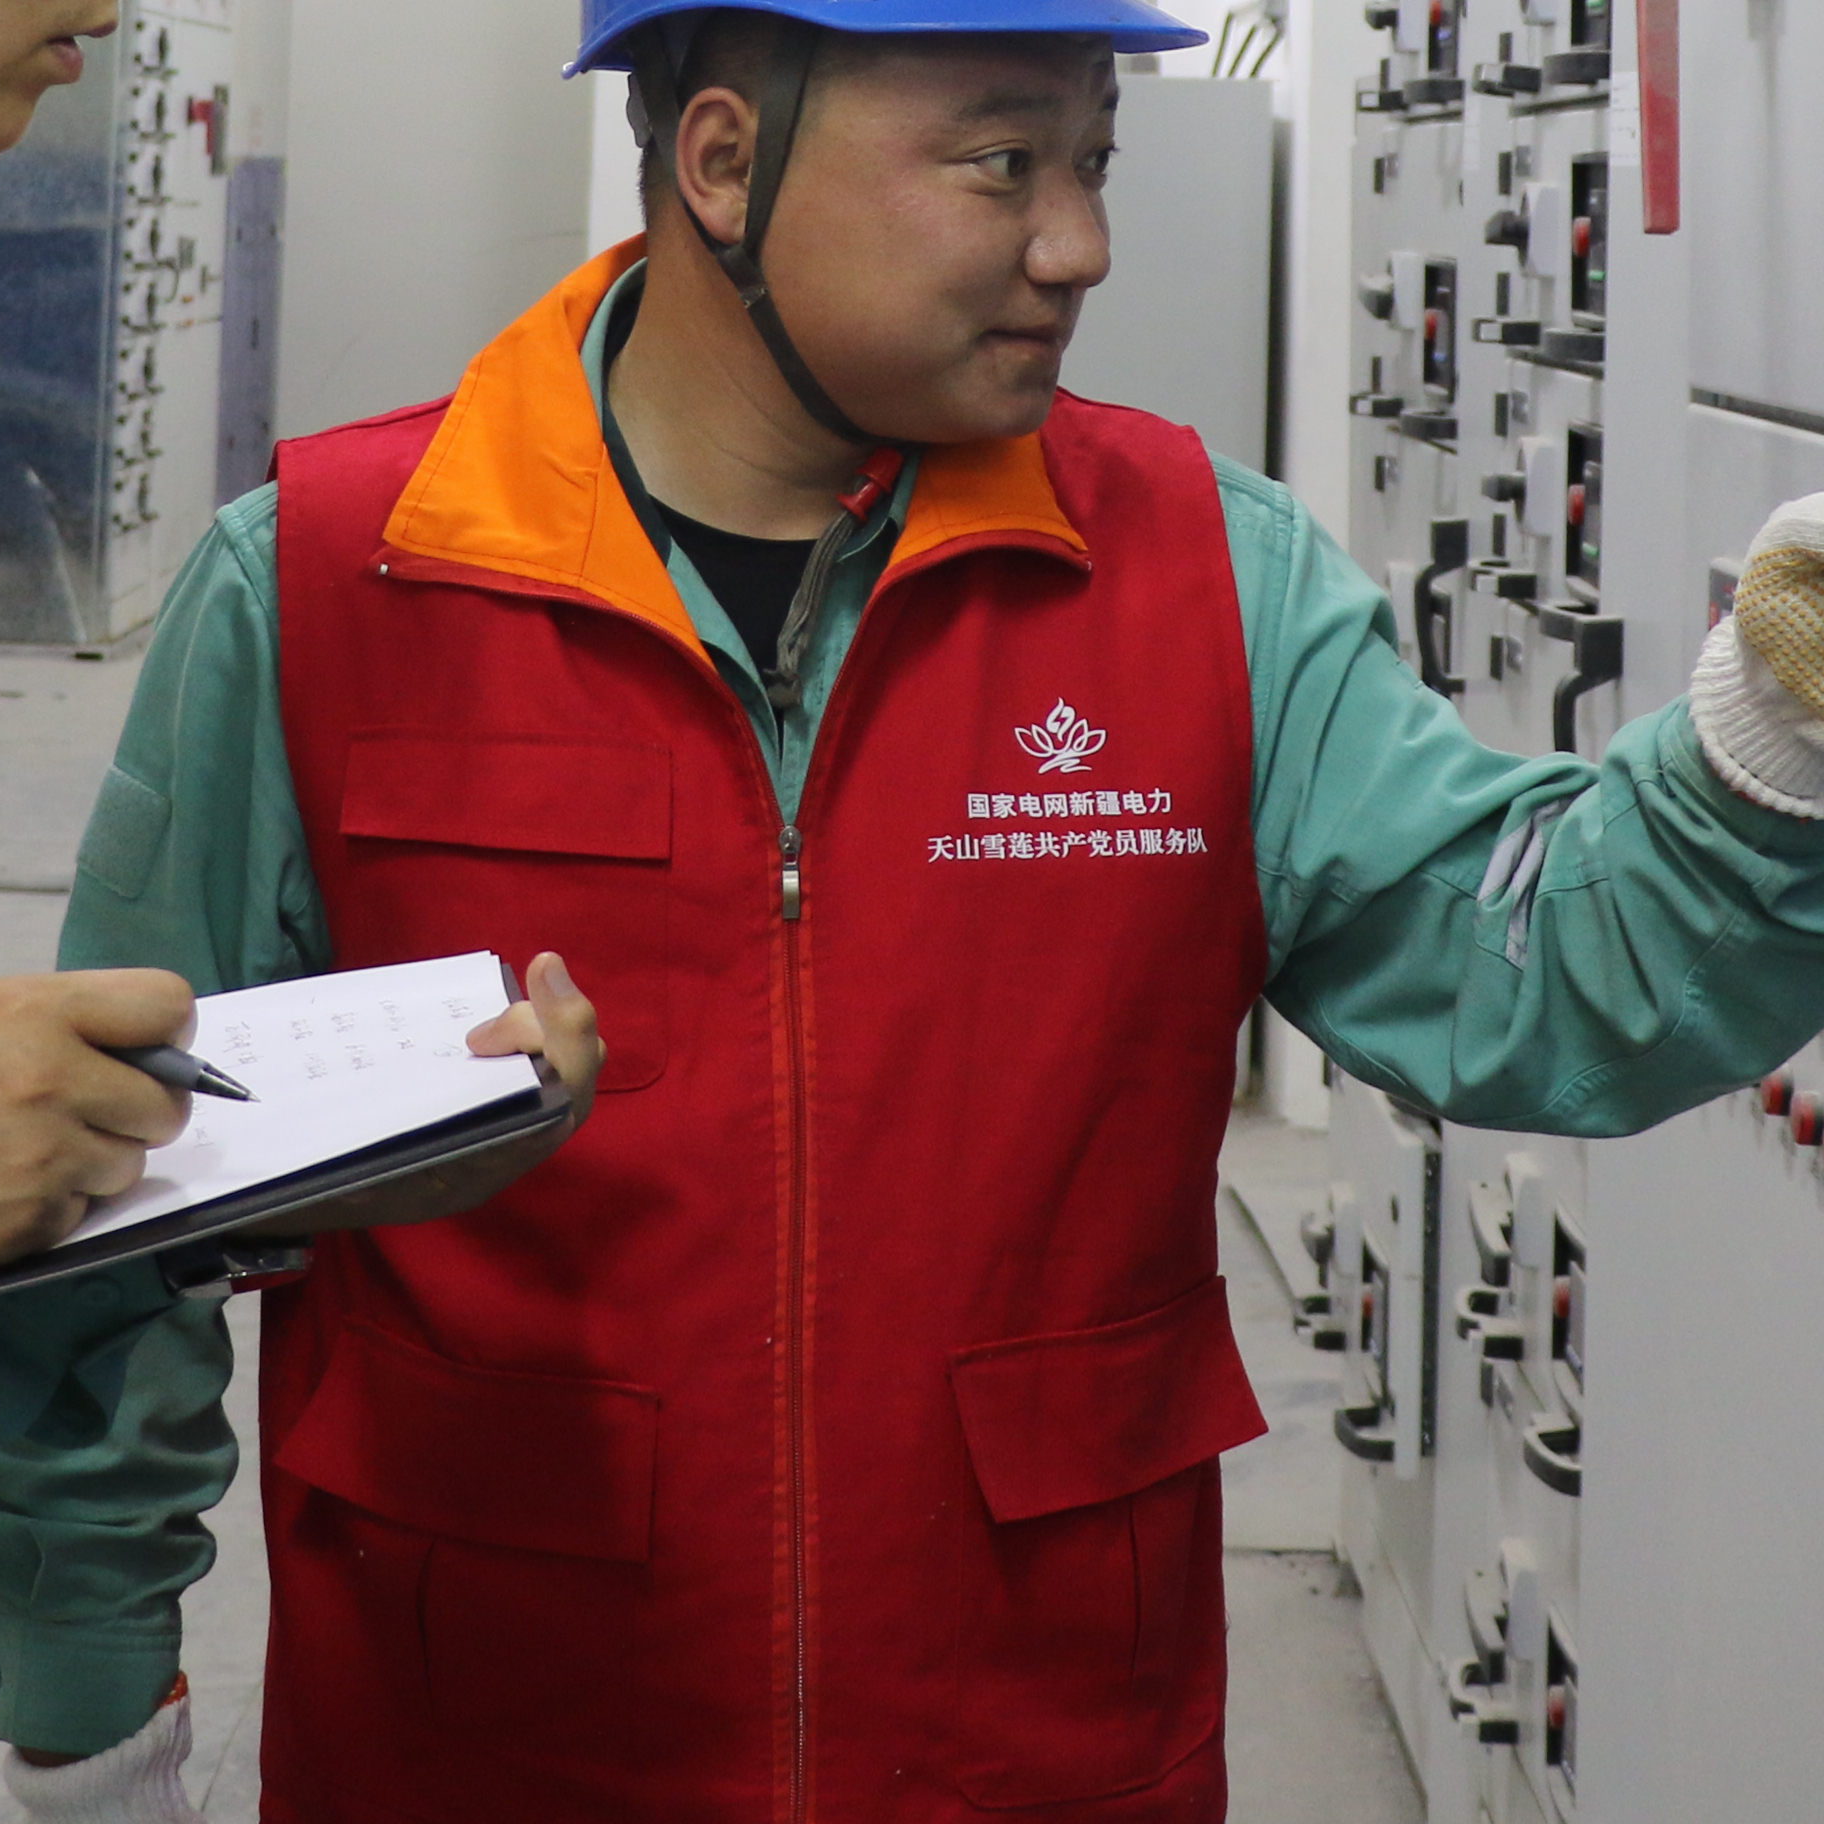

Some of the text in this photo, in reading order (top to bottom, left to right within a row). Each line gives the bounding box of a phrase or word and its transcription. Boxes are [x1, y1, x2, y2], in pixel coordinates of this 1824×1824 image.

[966, 788, 1173, 819] 国家电网新疆电力
[927, 827, 1209, 863] 天山雪莲共产党员服务队
